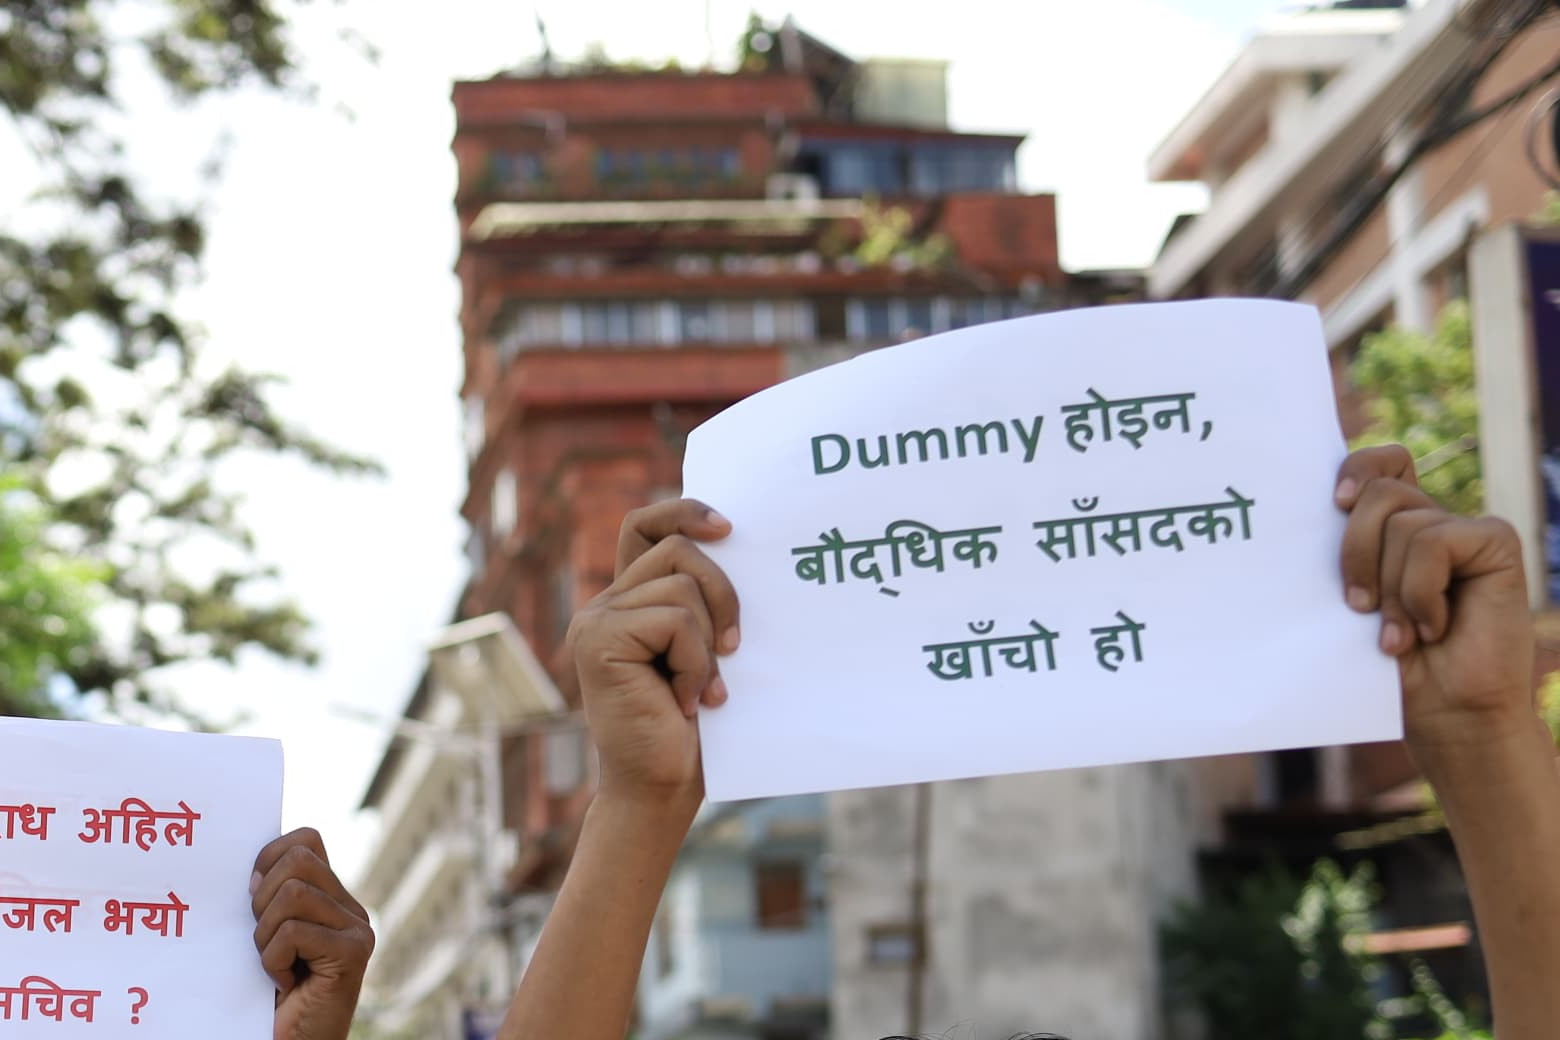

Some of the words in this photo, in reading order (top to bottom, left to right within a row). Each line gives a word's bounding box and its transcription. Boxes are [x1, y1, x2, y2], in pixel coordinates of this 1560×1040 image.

[810, 415, 1044, 476] Dummy
[1060, 387, 1213, 454] होइन,
[1032, 486, 1256, 563] साँसदको
[921, 619, 1060, 681] खाँचो
[1089, 610, 1146, 673] हो
[77, 797, 202, 853] अहिले
[103, 890, 190, 938] भयो
[127, 986, 149, 1025] ?
